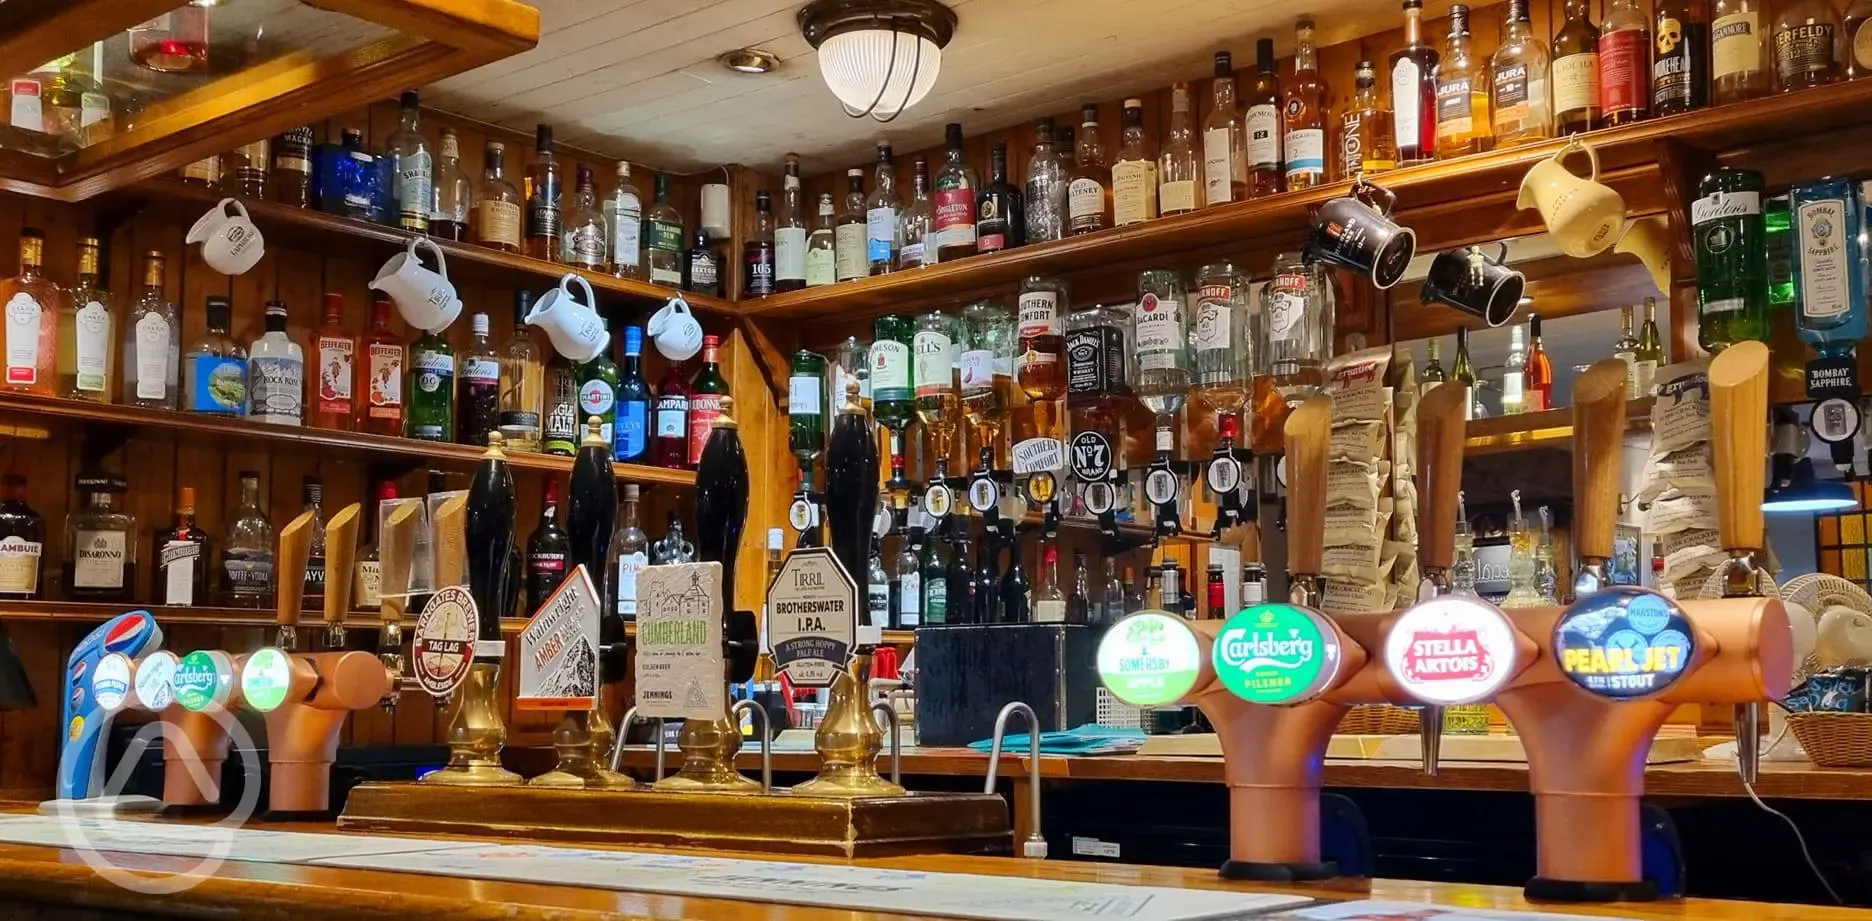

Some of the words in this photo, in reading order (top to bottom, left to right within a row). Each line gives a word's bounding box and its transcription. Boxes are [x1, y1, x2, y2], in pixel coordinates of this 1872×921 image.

[1776, 26, 1833, 48] BERFELDY
[1494, 68, 1526, 83] JURA
[1437, 82, 1470, 97] JURA
[1695, 198, 1748, 220] Gordon's
[751, 263, 771, 274] 105
[1199, 285, 1227, 299] RNOFF
[1019, 298, 1054, 315] OUTHERN
[1019, 310, 1051, 325] OMFORT
[320, 339, 352, 351] BEEFEATER
[370, 346, 402, 358] BEEFEATER
[917, 341, 942, 356] ELL'S
[1811, 367, 1850, 379] BOMBAY
[1810, 377, 1853, 390] SAPPHIRE
[1080, 436, 1097, 446] OLD
[1018, 439, 1060, 464] SOUTHERN
[1025, 452, 1060, 472] COMFORT
[0, 544, 39, 554] AMBUIE
[79, 549, 122, 560] DISARONNO
[305, 569, 325, 581] AYV
[776, 599, 845, 615] BROTHERSWATER
[415, 588, 458, 648] BARNGATES
[456, 590, 478, 650] BREWERY
[525, 586, 580, 647] Wainwright
[797, 616, 827, 632] I.P.A.
[641, 619, 707, 647] CUMBERLAND
[428, 641, 444, 652] TAG
[444, 641, 460, 653] LAG
[533, 631, 566, 673] AMBER
[790, 640, 815, 652] STRONG
[815, 640, 837, 652] HOPPY
[796, 649, 812, 658] PALE
[812, 649, 825, 658] ALE
[1221, 627, 1313, 666] Carlsberg
[1412, 638, 1478, 657] STELLA
[1119, 656, 1171, 672] SOMERSBY
[1414, 655, 1479, 674] ARTOIS
[1563, 647, 1639, 675] PEARL
[1639, 645, 1681, 673] JET
[1244, 676, 1293, 690] PILSNER
[1610, 674, 1655, 688] STOUT
[642, 690, 673, 701] JENNINGS
